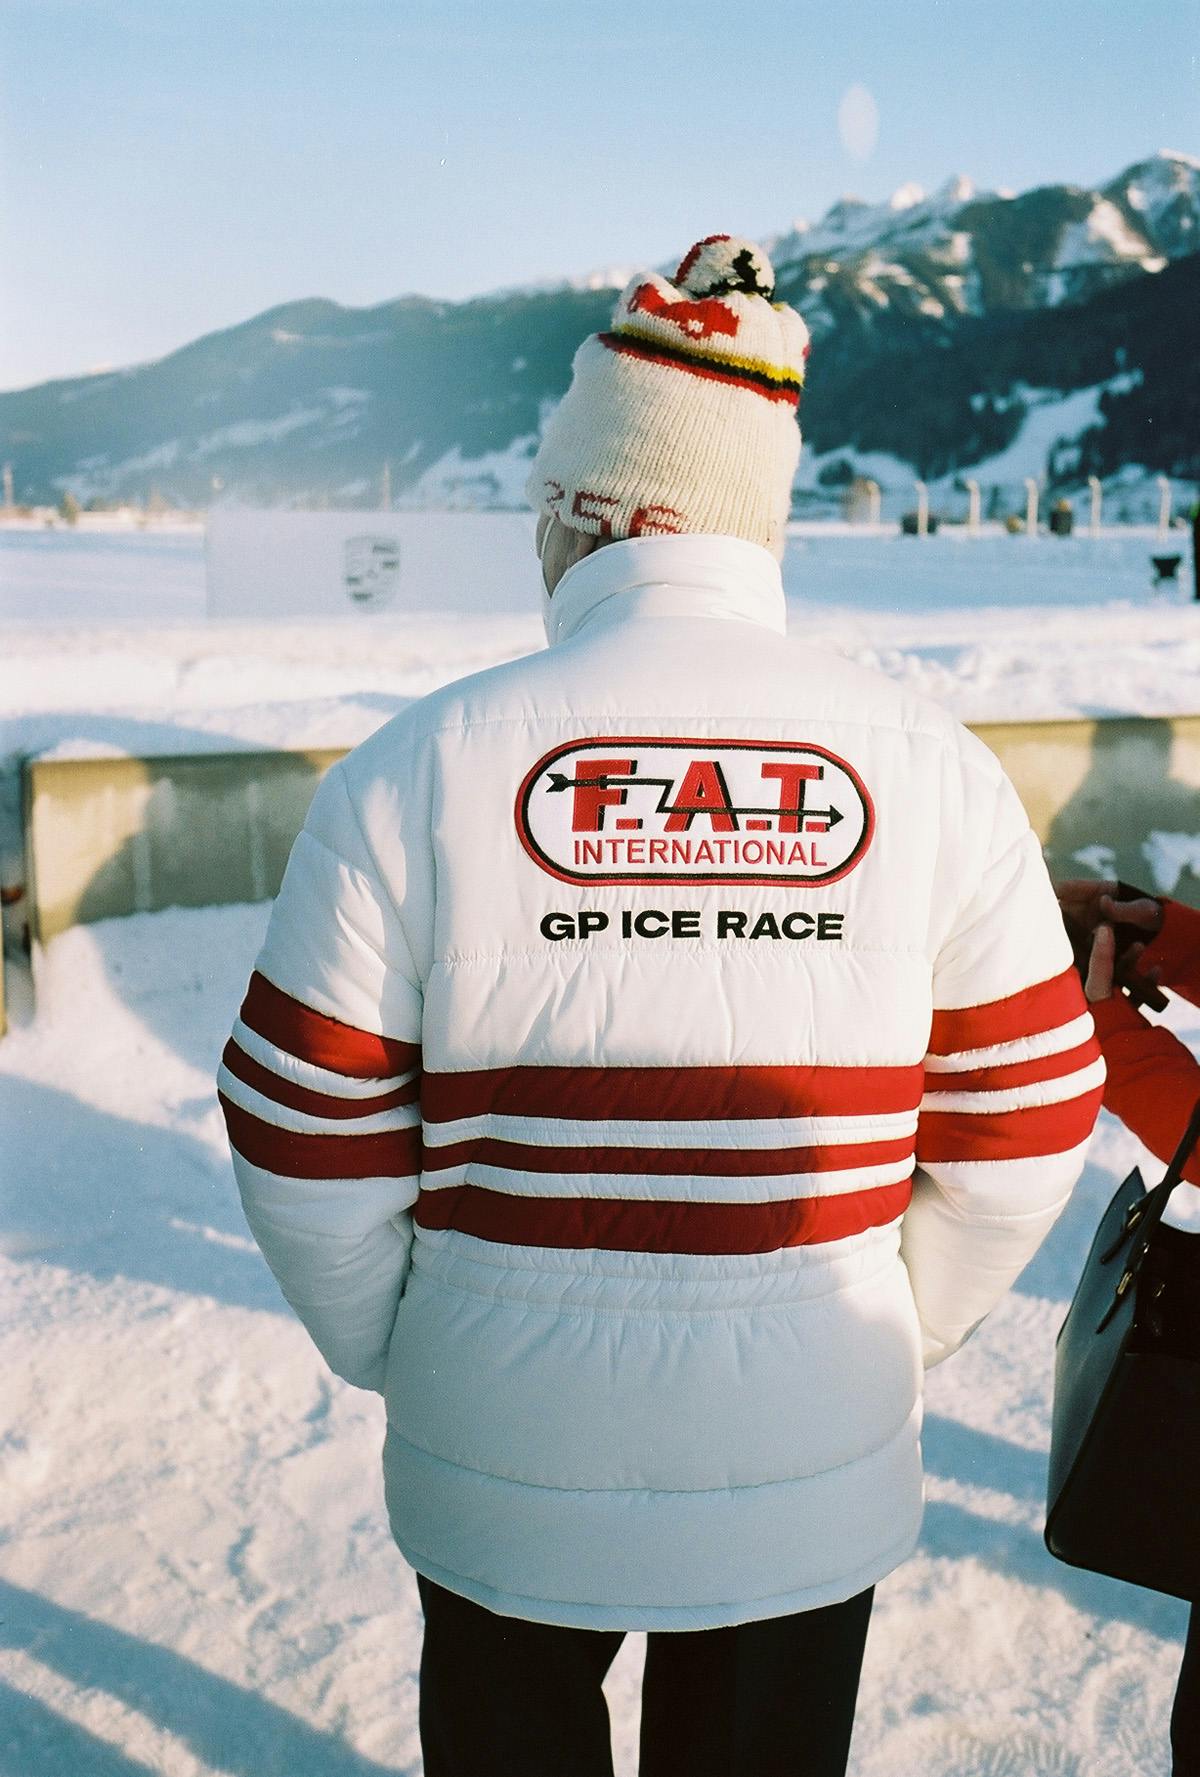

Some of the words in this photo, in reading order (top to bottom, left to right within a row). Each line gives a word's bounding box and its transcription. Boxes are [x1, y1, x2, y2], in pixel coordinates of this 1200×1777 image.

[571, 759, 830, 833] F.A.T.
[574, 838, 828, 867] INTERNATIONAL
[539, 911, 610, 941] GP
[621, 910, 701, 940] ICE
[716, 911, 845, 941] RACE
